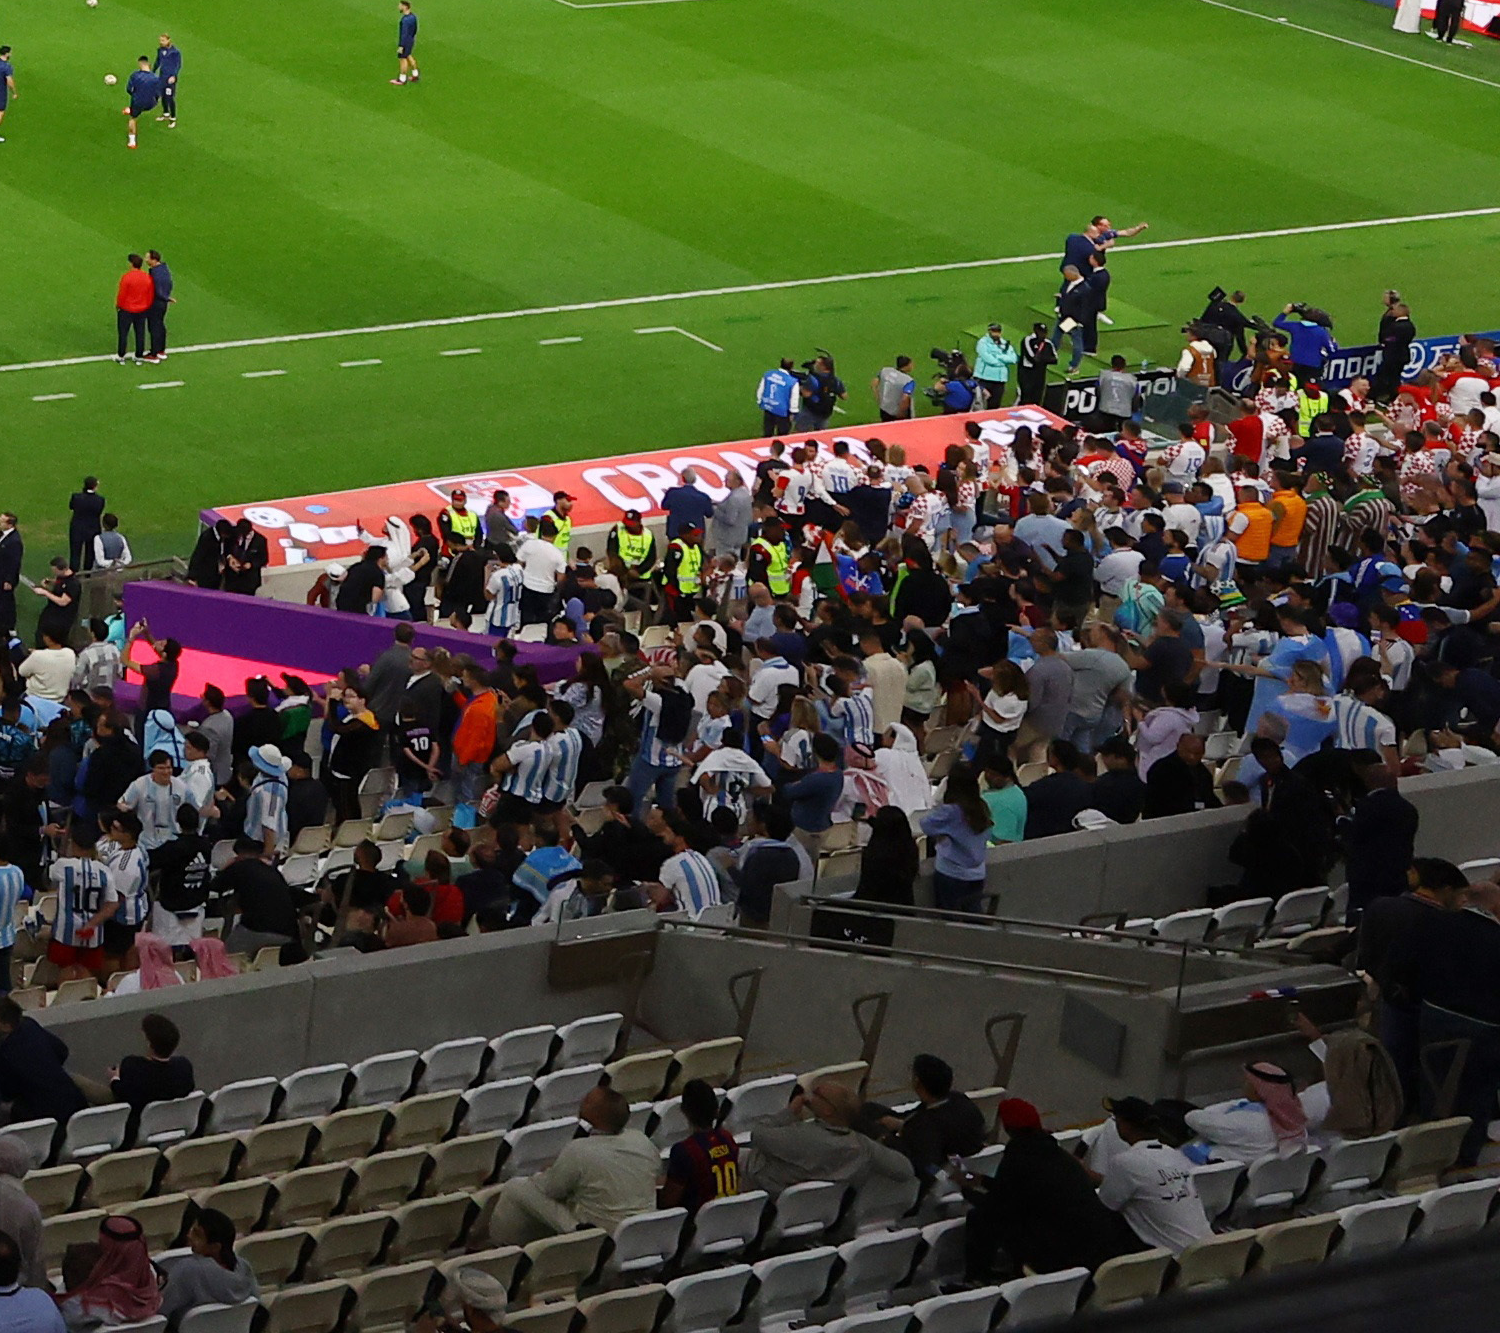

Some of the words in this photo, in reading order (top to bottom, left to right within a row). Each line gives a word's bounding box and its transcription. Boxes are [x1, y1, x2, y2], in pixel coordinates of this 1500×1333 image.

[582, 436, 874, 513] CROAA
[410, 737, 429, 752] 10
[710, 1161, 739, 1197] 10
